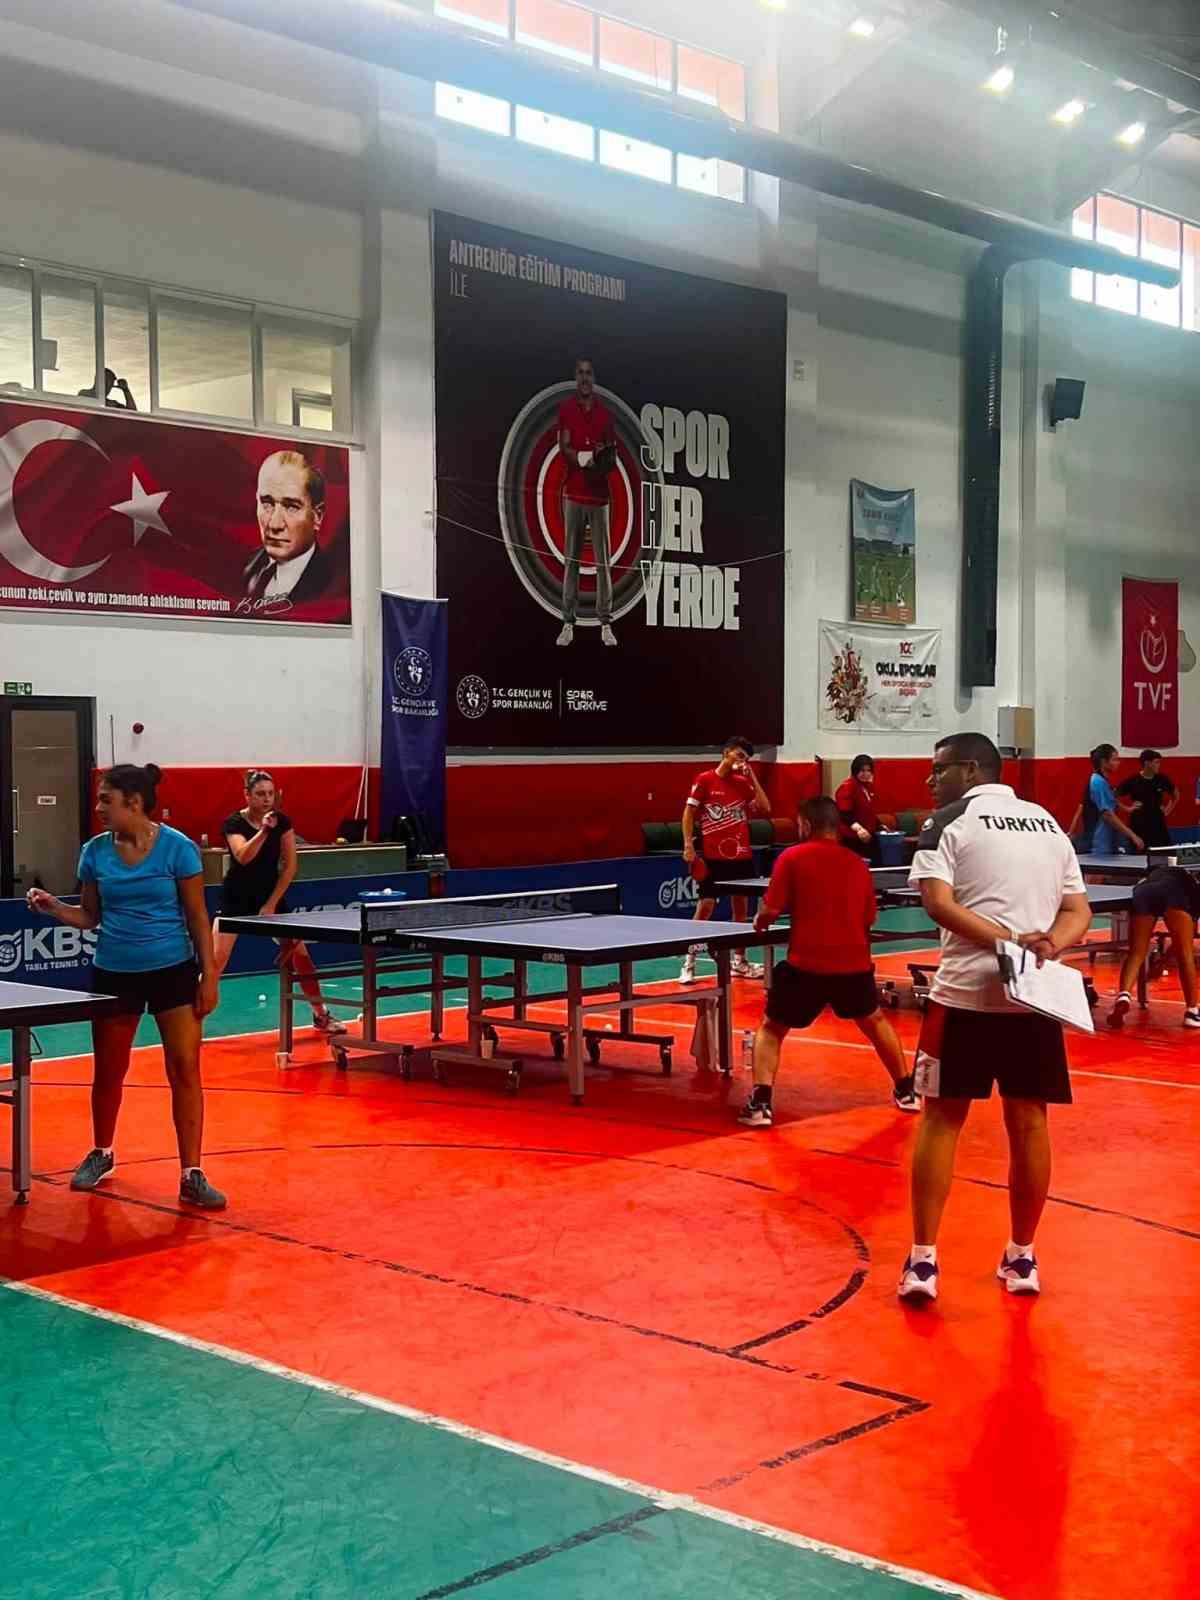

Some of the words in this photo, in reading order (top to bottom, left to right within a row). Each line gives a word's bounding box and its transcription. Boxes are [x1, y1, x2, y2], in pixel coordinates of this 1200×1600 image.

[450, 239, 517, 278] ANTRENÖR
[519, 254, 561, 288] EĞİTİM
[563, 267, 626, 301] PROGRAMI
[640, 403, 730, 480] SPOR
[641, 481, 704, 553] HER
[75, 590, 87, 603] ve
[88, 591, 108, 605] aynı
[109, 593, 149, 607] zamanda
[196, 598, 230, 612] severim
[640, 560, 740, 631] YERDE
[492, 688, 507, 697] T.C.
[542, 689, 552, 699] VE
[492, 700, 513, 709] SPOR
[1134, 681, 1172, 711] TVF
[978, 815, 1057, 834] TÜRKİYE
[25, 963, 49, 972] TABLE
[50, 960, 79, 970] TENNIS
